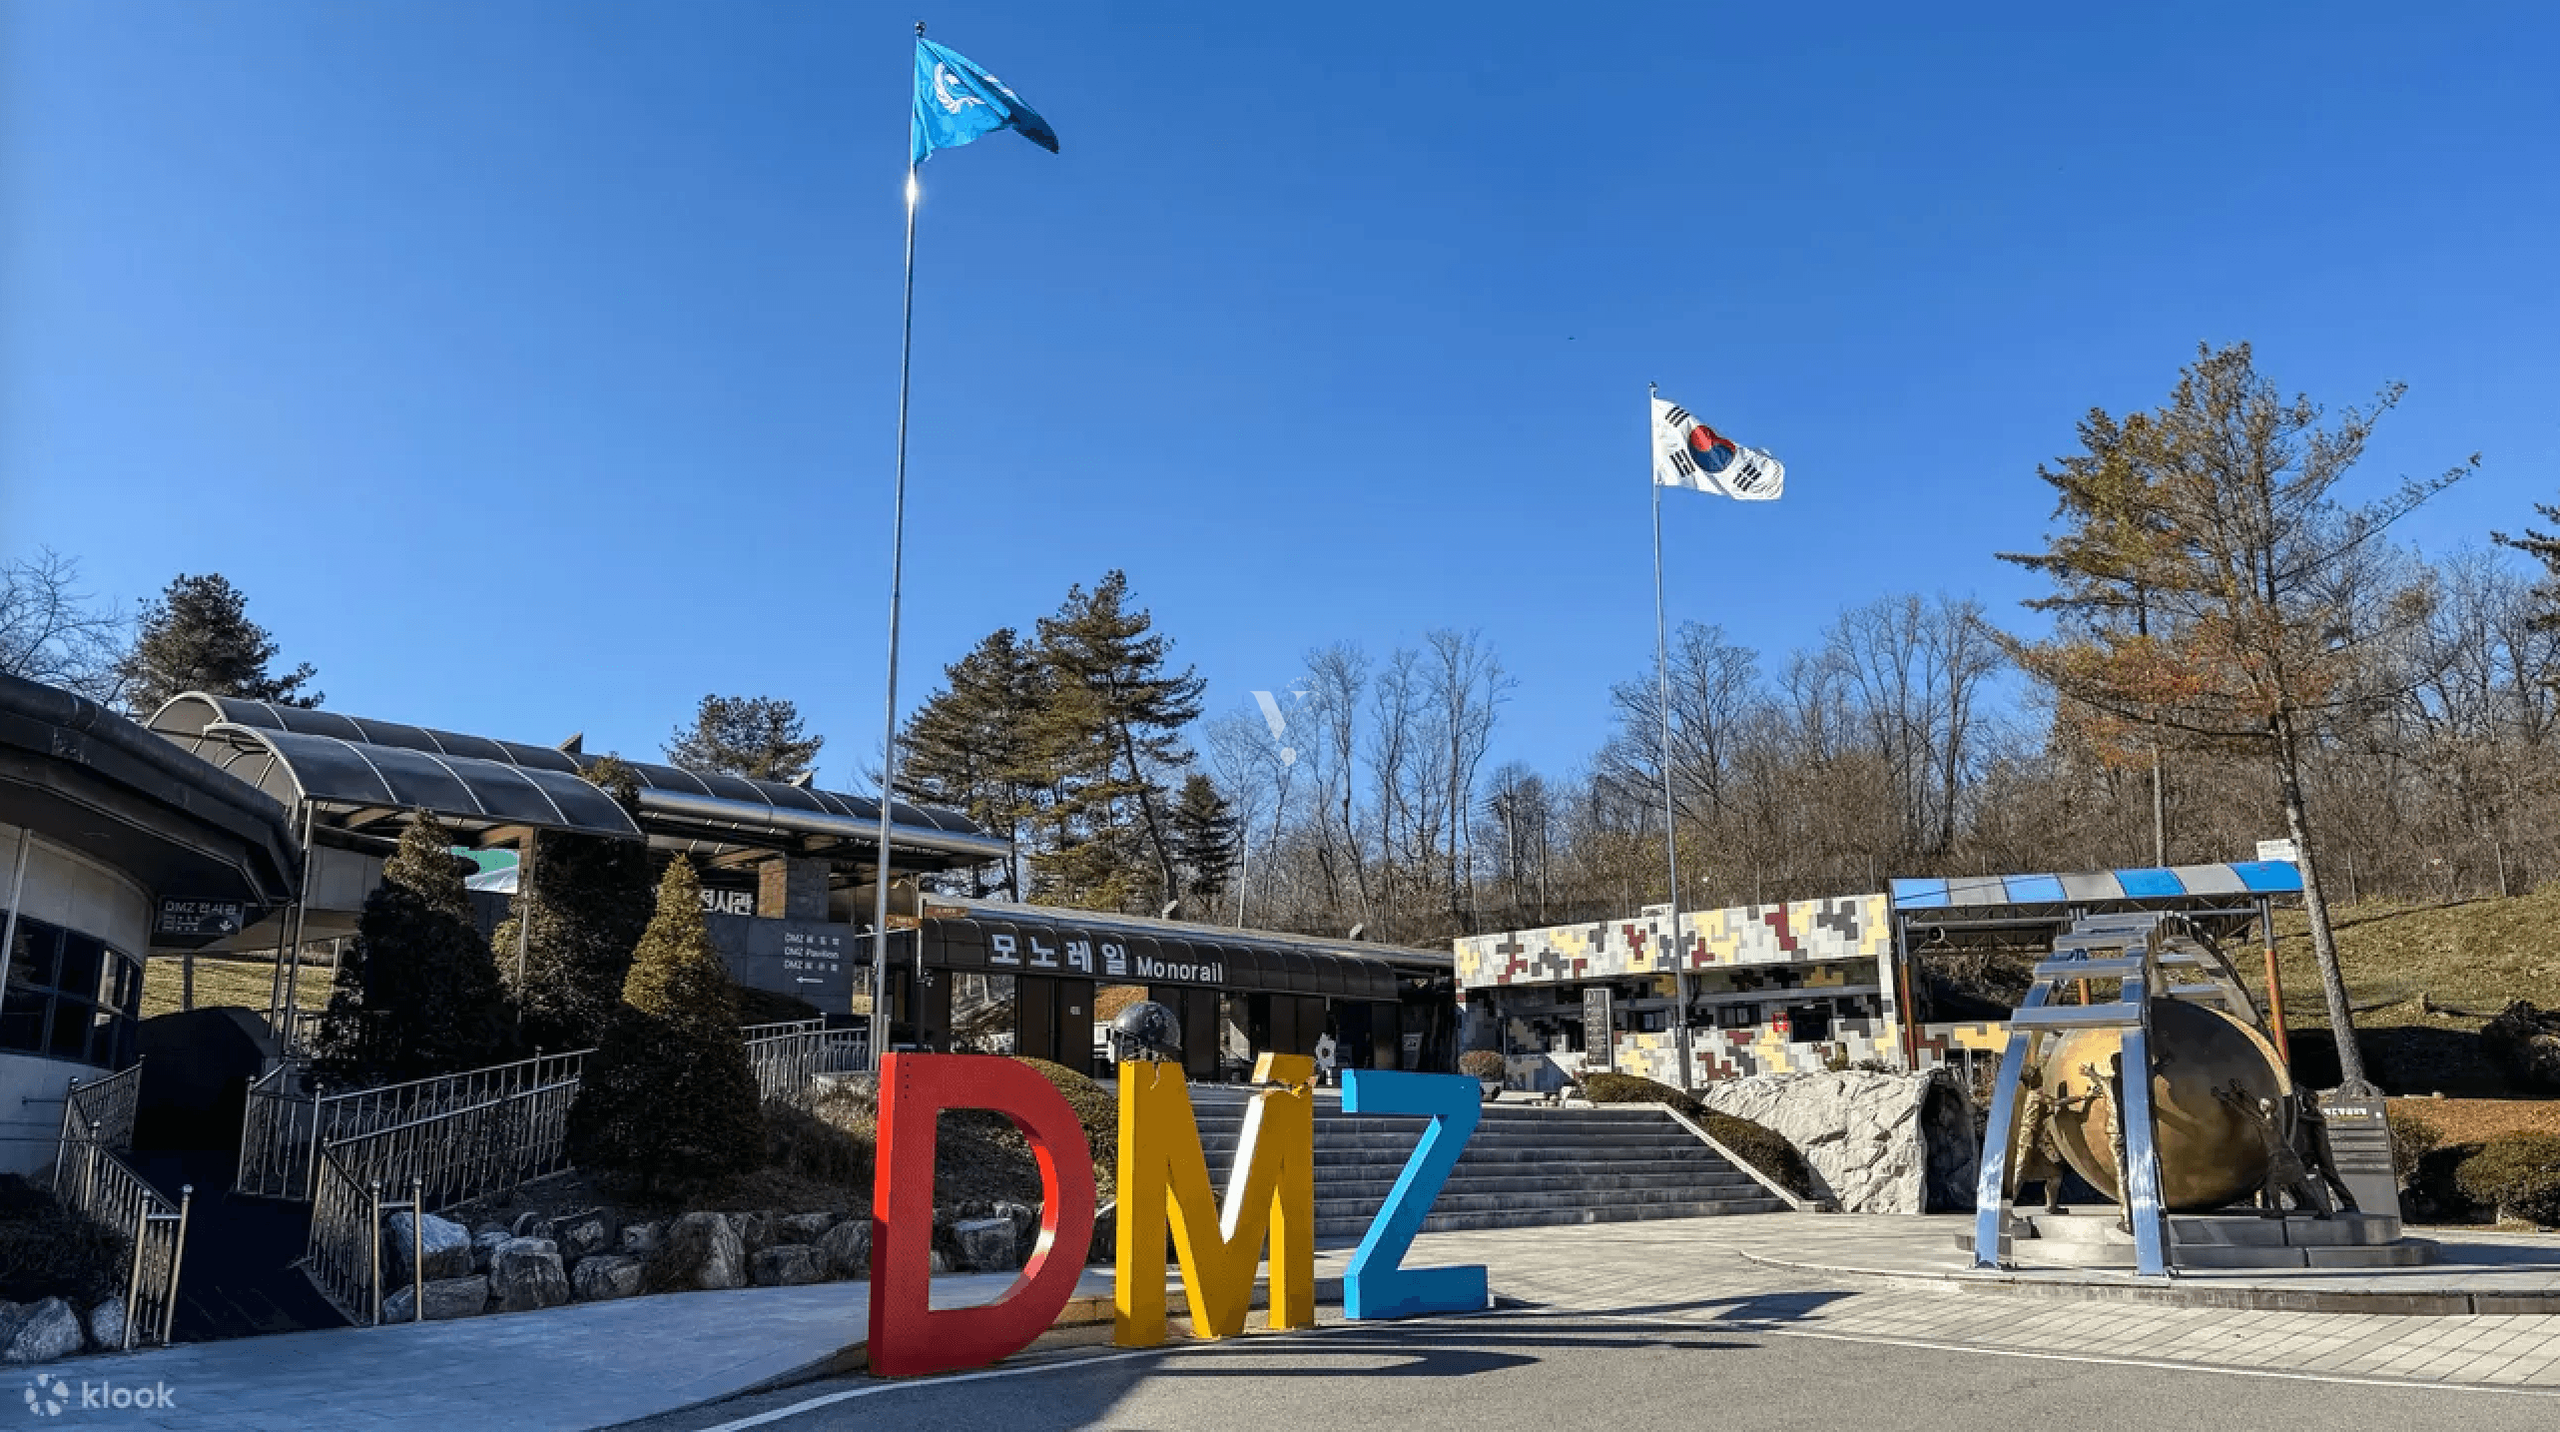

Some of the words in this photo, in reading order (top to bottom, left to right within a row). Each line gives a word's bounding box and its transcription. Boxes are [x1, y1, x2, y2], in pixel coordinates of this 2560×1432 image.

[990, 934, 1128, 976] 모노레일
[1136, 956, 1223, 983] Monorail
[868, 1051, 1489, 1377] DMZ
